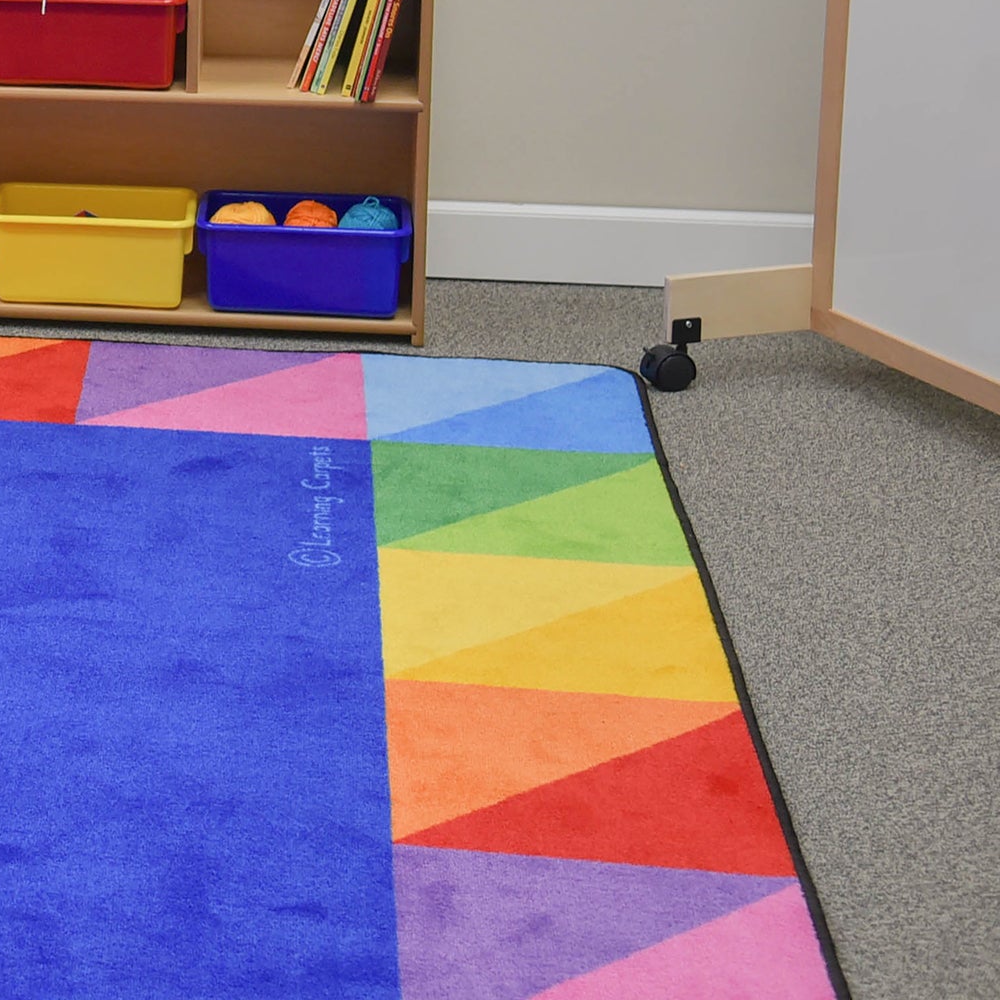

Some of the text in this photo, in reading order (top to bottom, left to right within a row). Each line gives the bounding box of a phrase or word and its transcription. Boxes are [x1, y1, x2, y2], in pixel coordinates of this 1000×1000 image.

[388, 1, 400, 27] Snores
[384, 27, 393, 39] On
[300, 445, 344, 490] Carpets
